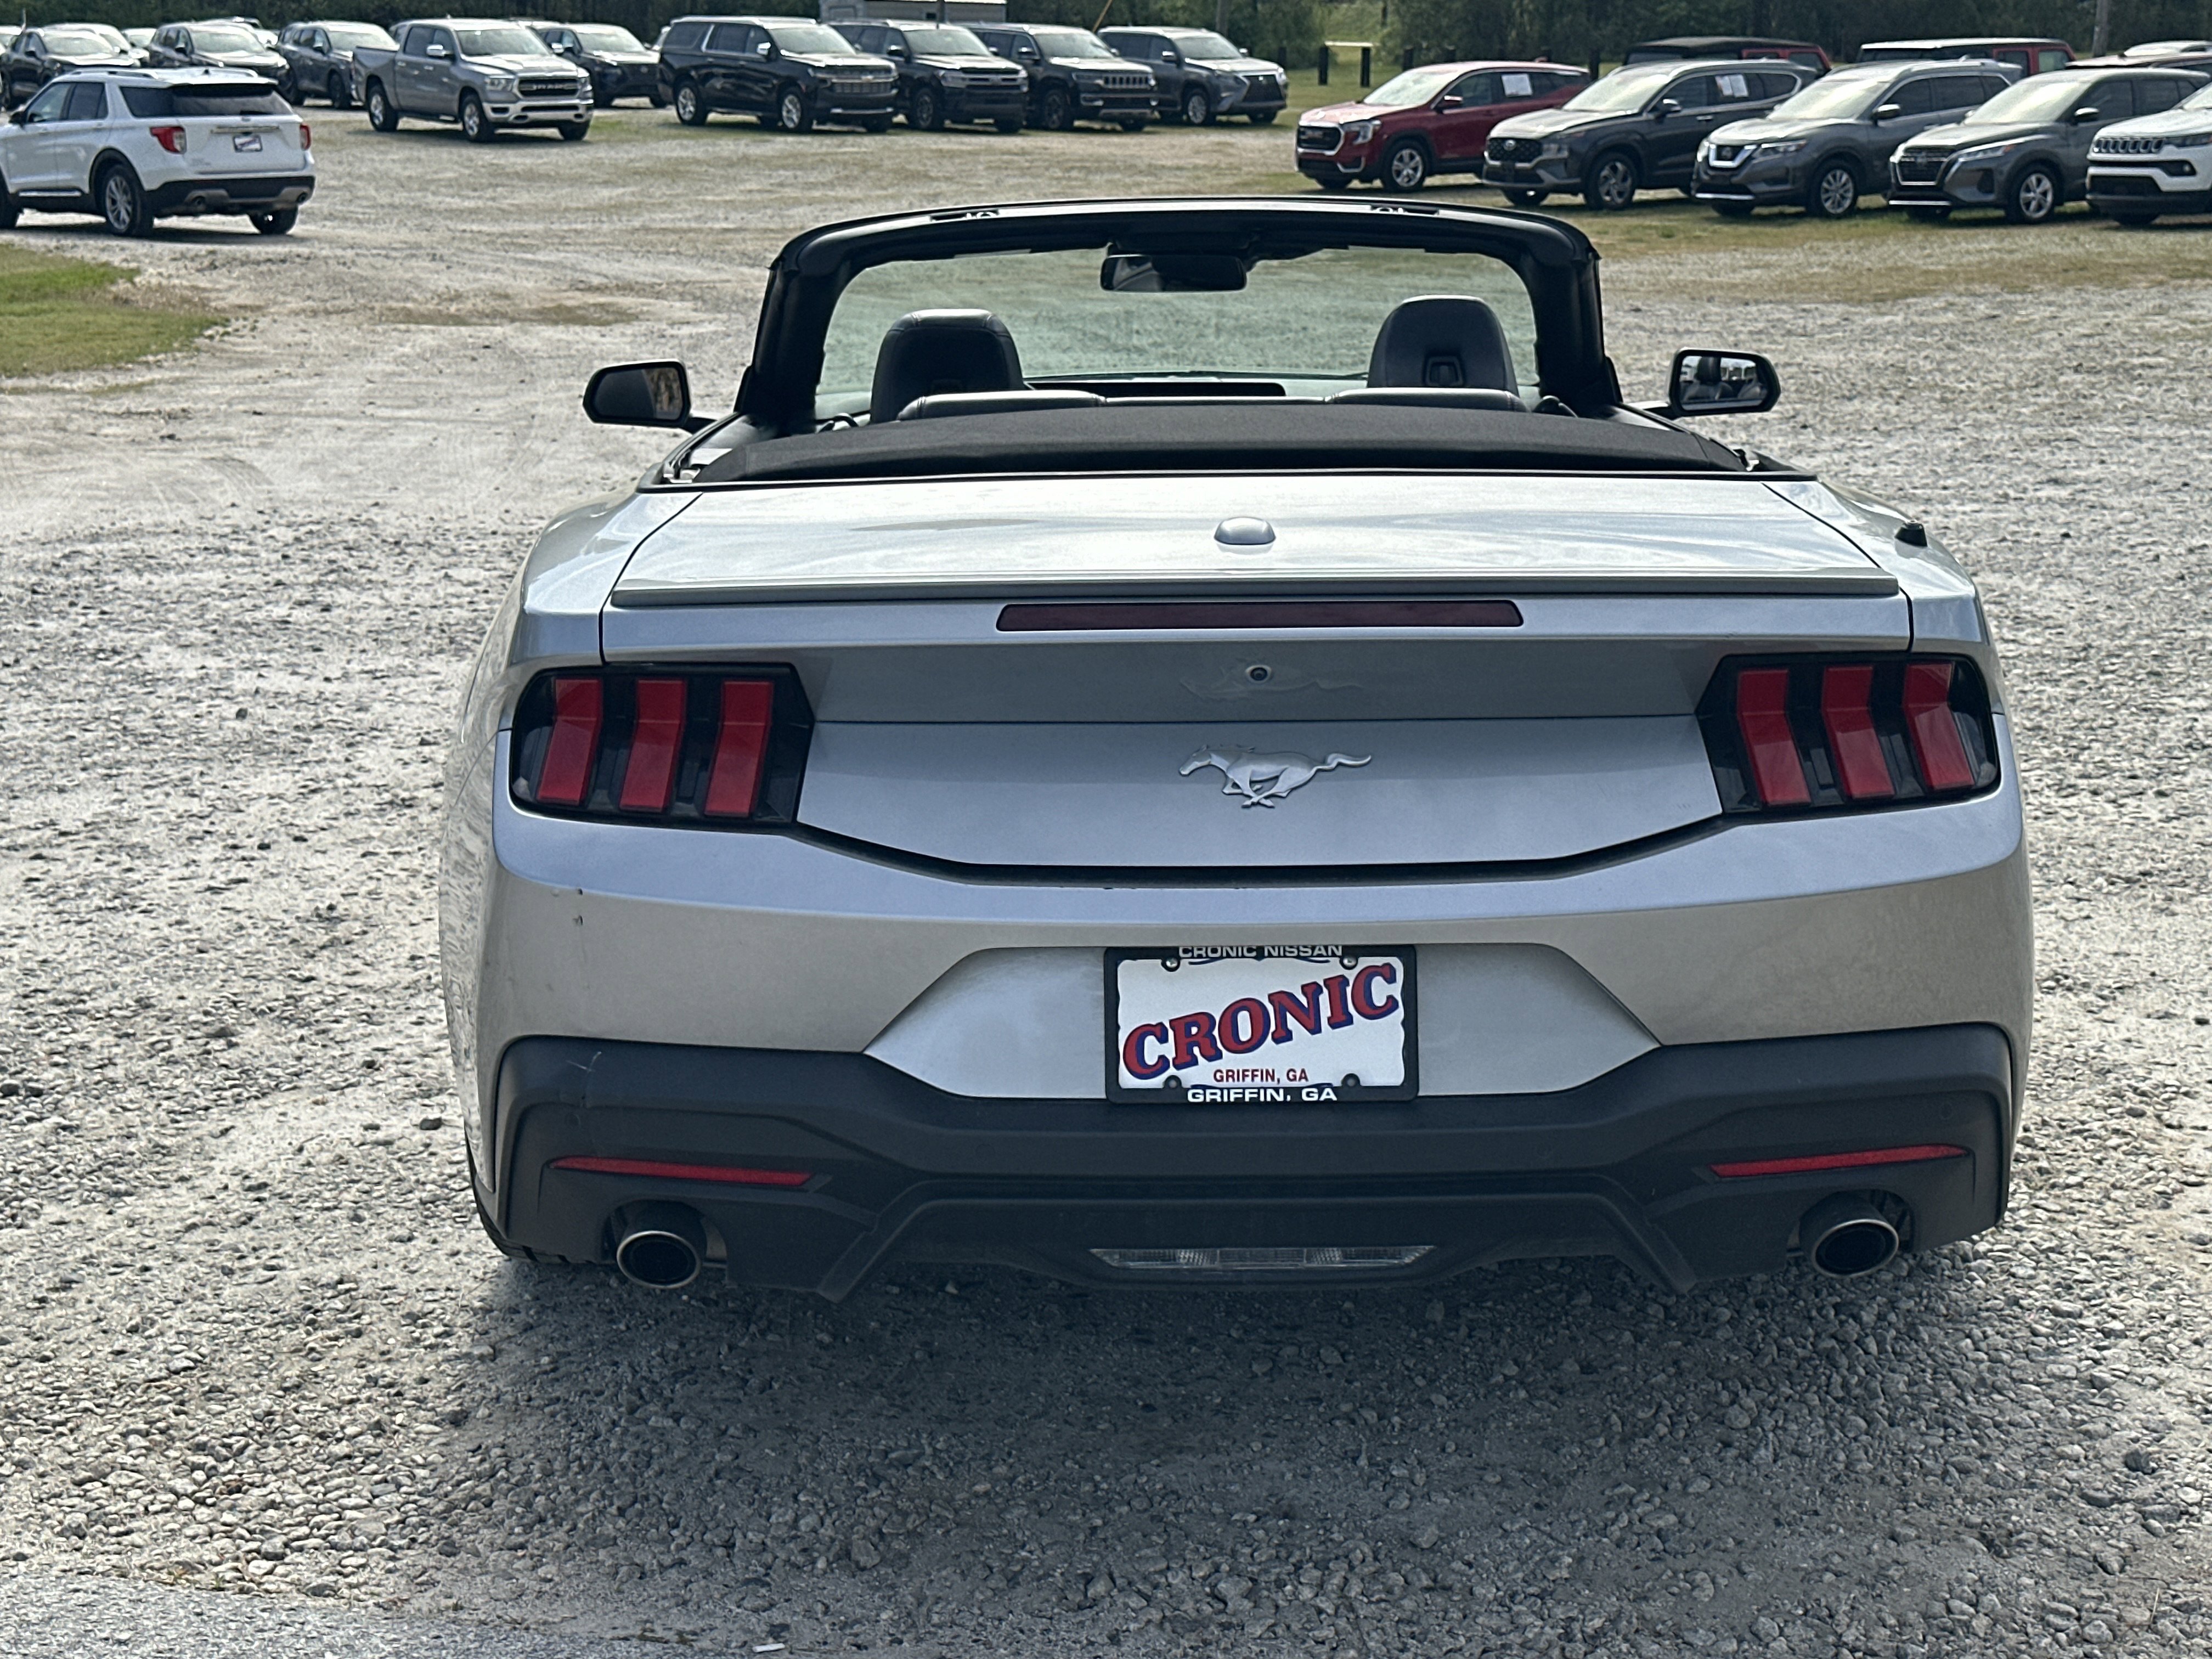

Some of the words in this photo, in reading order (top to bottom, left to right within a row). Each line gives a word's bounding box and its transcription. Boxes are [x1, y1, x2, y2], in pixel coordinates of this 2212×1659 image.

[1179, 946, 1257, 958] CRONIC
[1264, 945, 1343, 957] NISSAN
[1123, 963, 1399, 1080] CRONIC
[1213, 1069, 1280, 1084] GRIFFIN,
[1286, 1069, 1309, 1082] GA
[1187, 1088, 1291, 1102] GRIFFIN,
[1301, 1088, 1338, 1102] GA
